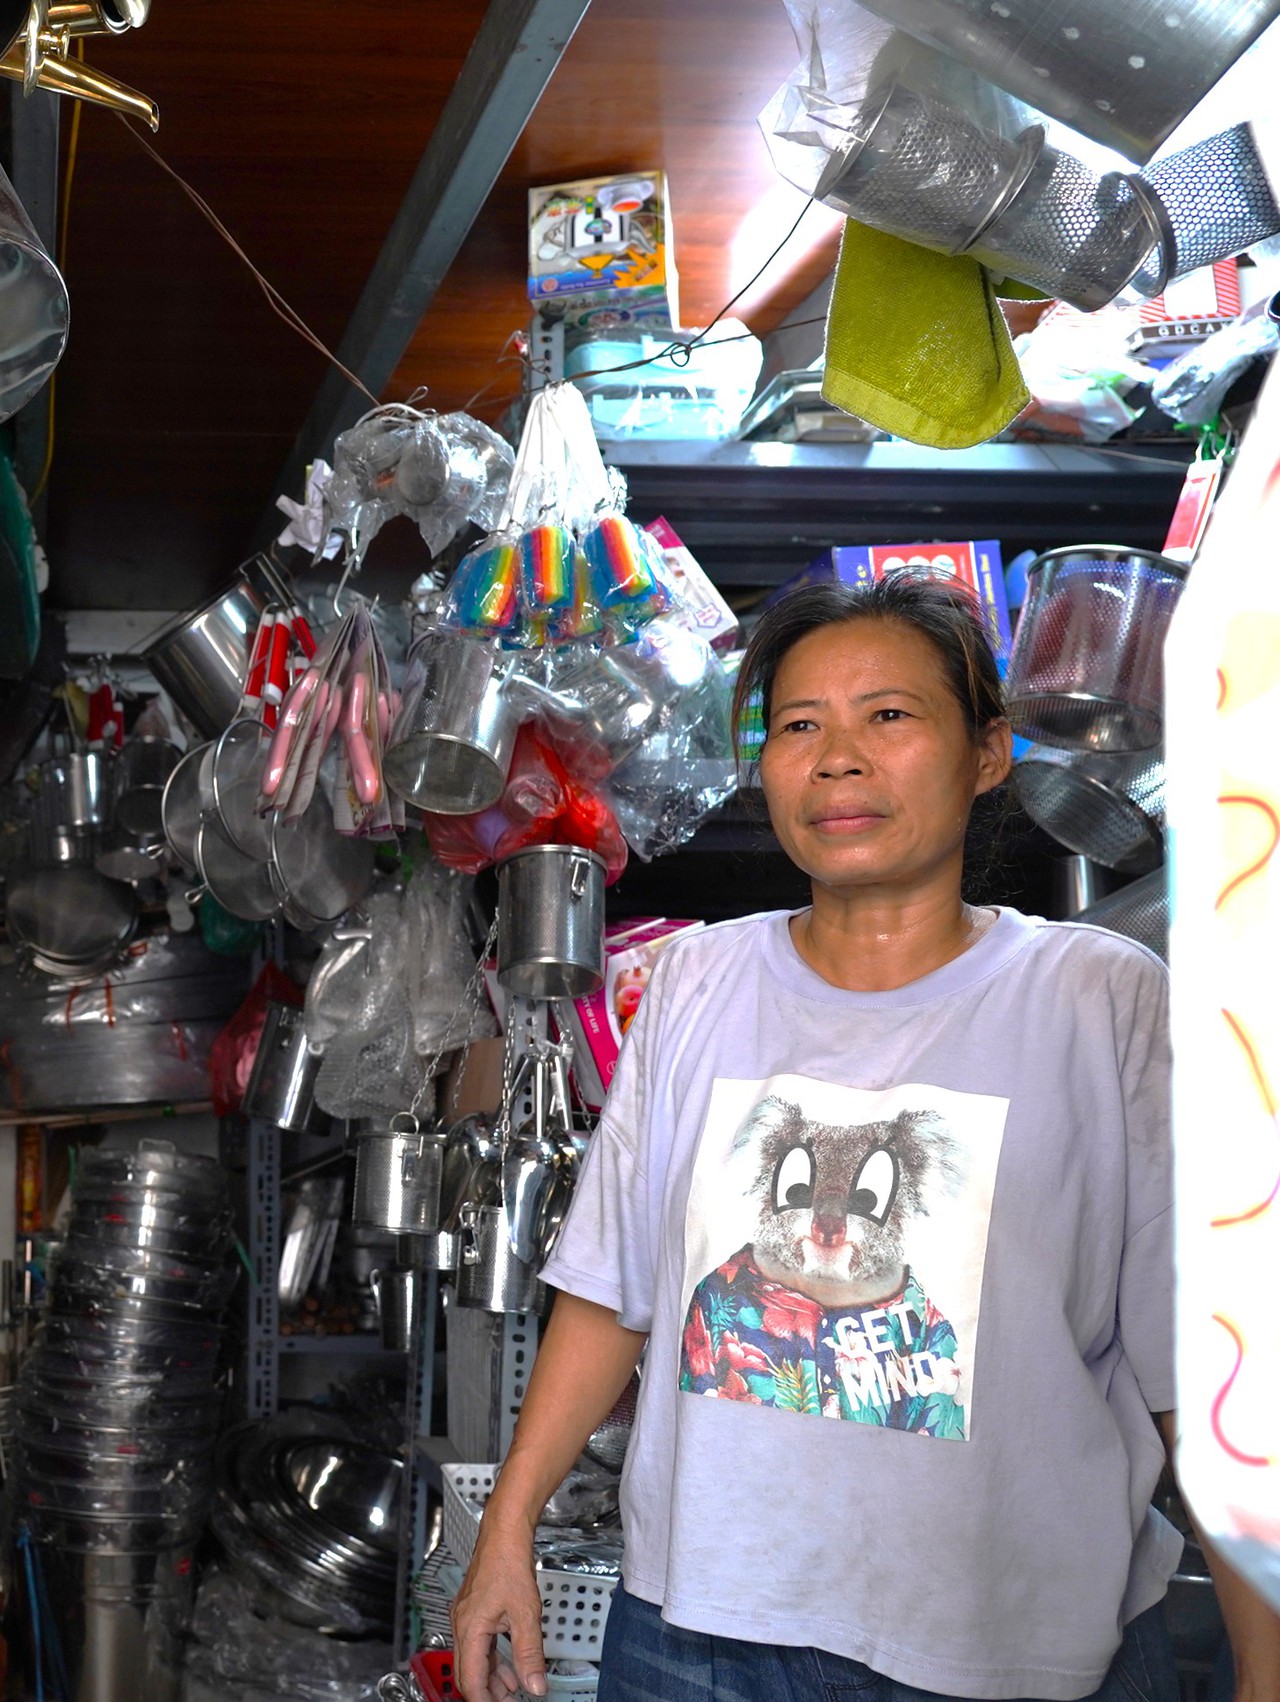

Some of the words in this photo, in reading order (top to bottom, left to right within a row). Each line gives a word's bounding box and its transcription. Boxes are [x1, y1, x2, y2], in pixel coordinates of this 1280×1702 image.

[585, 1007, 595, 1018] OF
[589, 1017, 600, 1034] LIFE
[834, 1301, 914, 1359] GET
[838, 1350, 941, 1412] MIND
